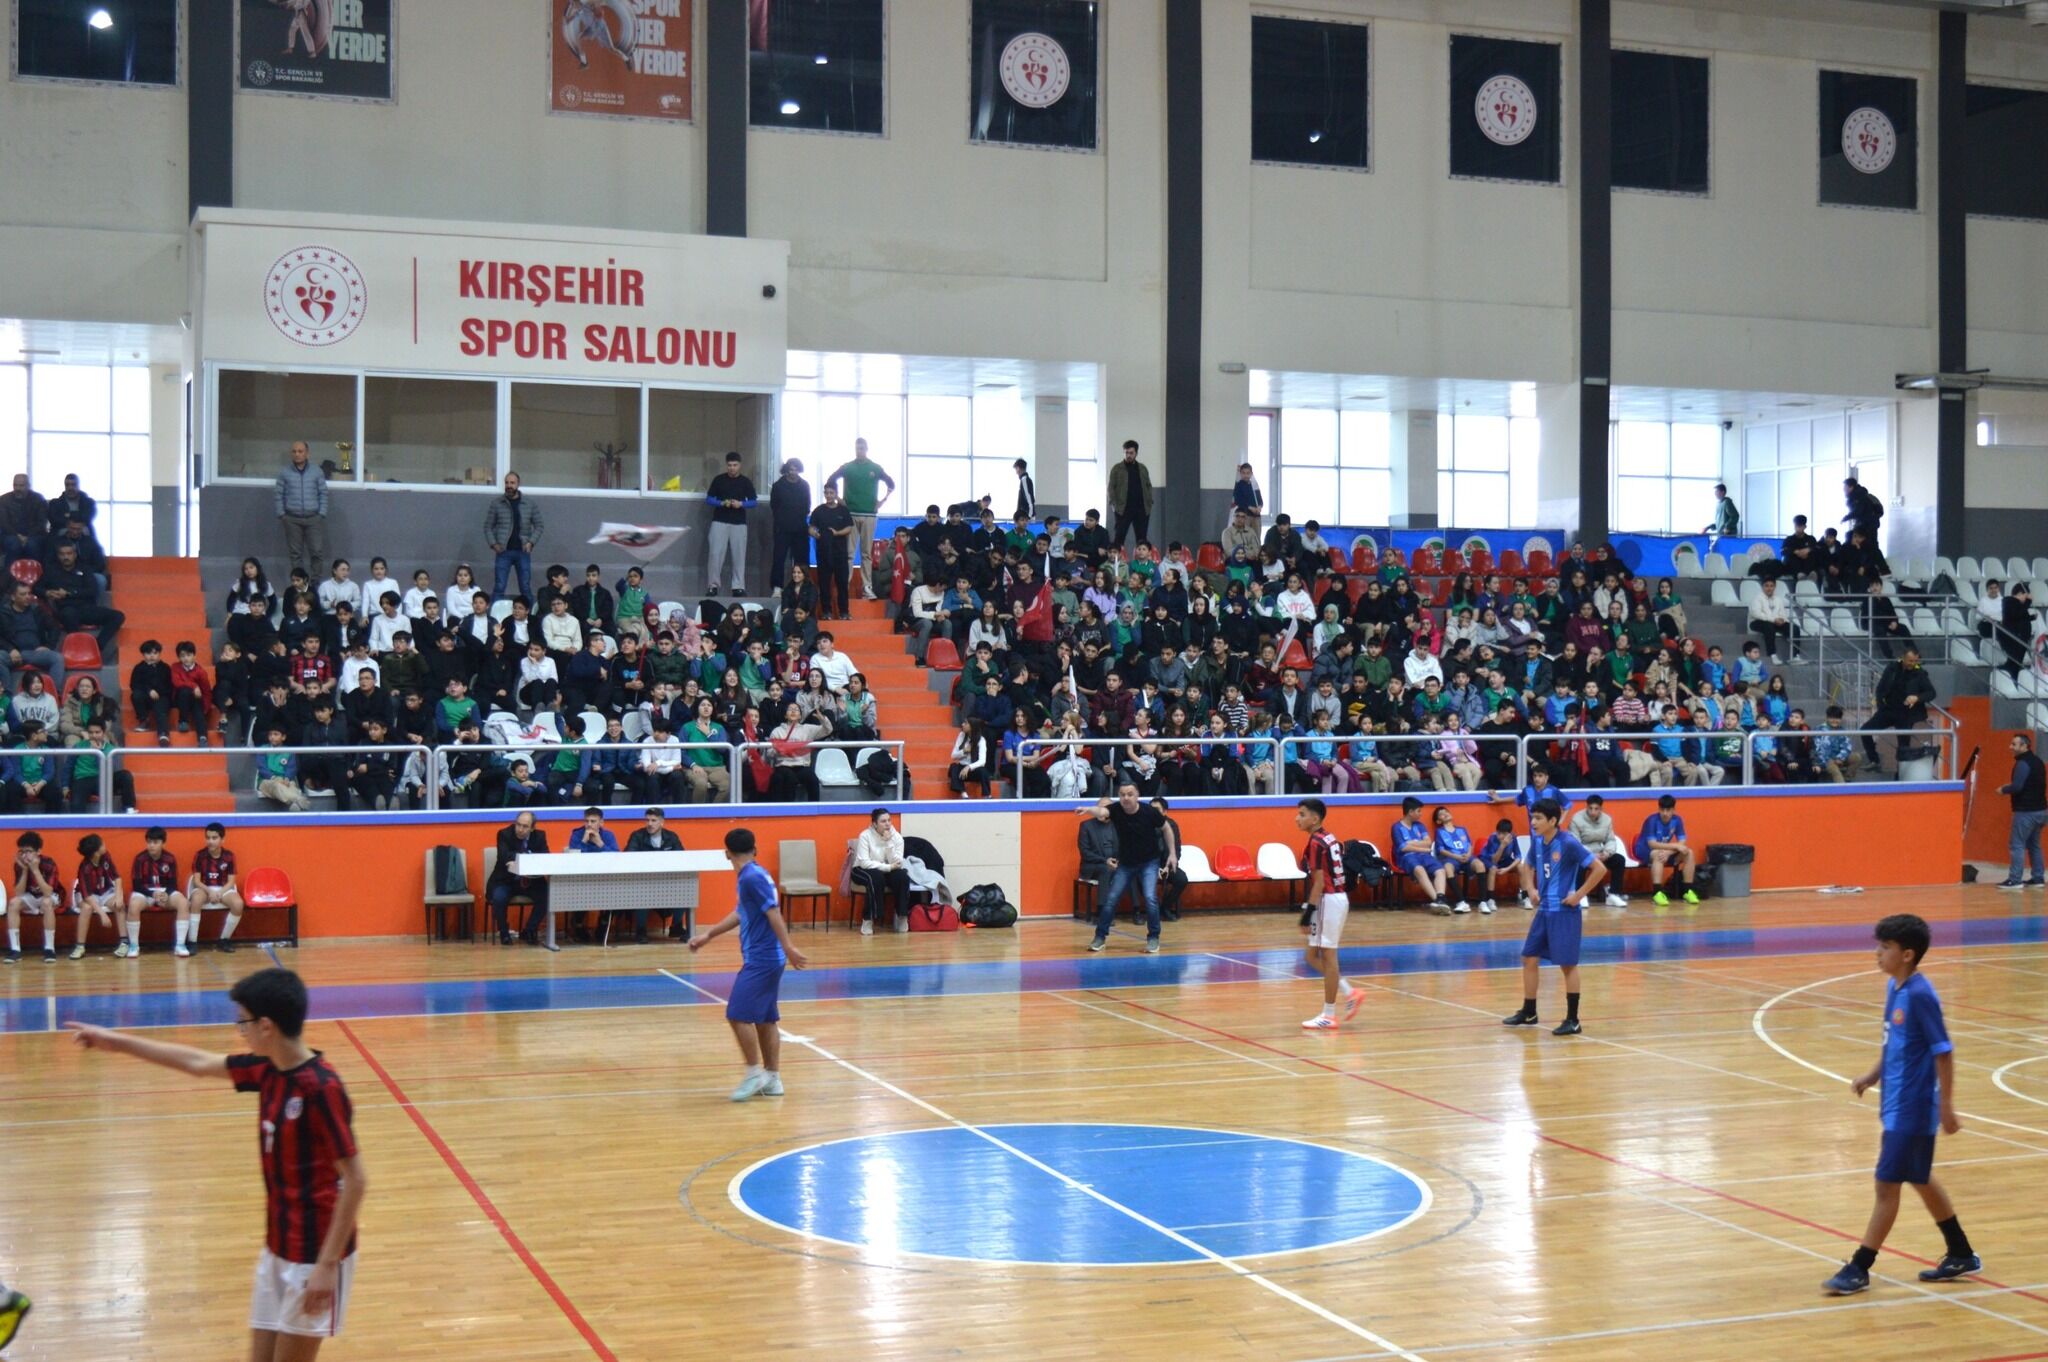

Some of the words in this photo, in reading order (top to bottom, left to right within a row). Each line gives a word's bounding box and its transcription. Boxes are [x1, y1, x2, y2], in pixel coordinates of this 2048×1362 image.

[327, 31, 386, 64] YERDE
[632, 48, 687, 78] YERDE
[459, 258, 645, 308] KIRŞEHİR
[459, 318, 568, 361] SPOR
[583, 324, 737, 369] SALONU
[729, 704, 737, 716] 7
[1543, 863, 1552, 879] 5
